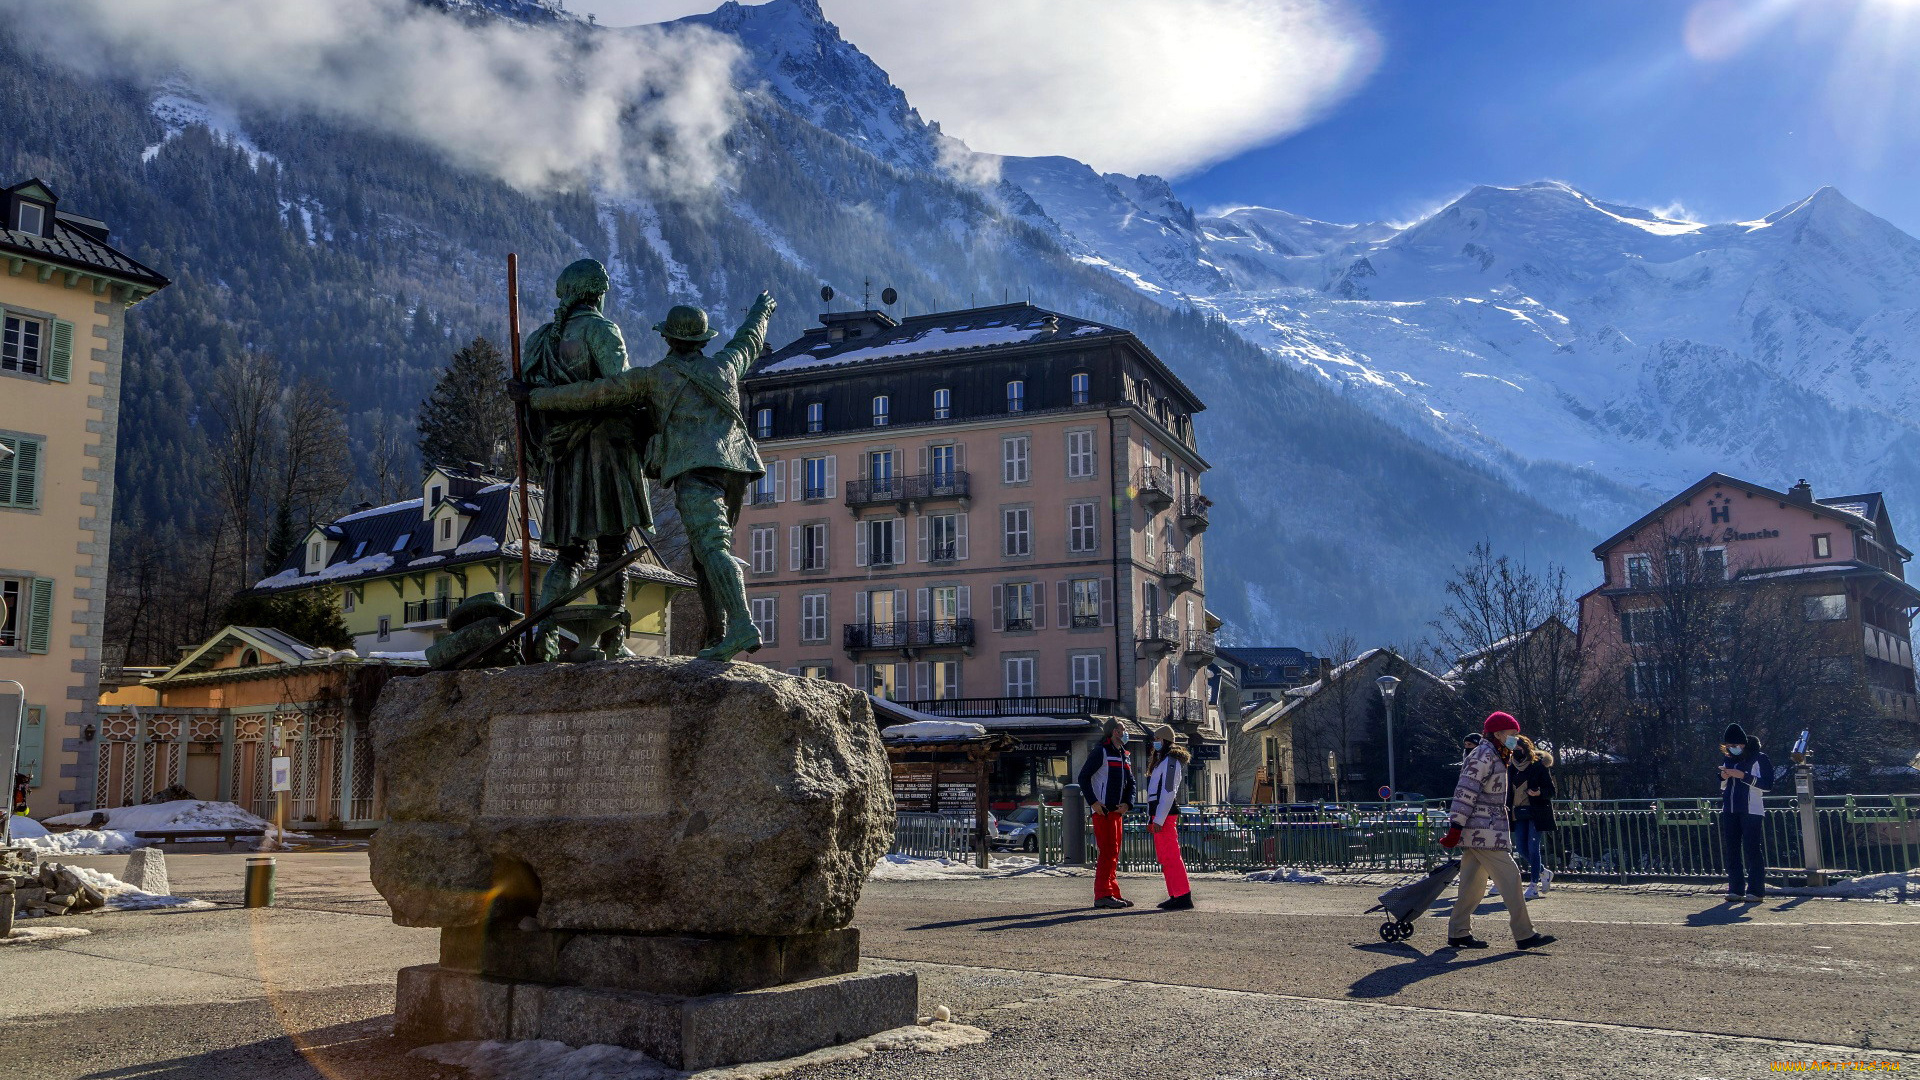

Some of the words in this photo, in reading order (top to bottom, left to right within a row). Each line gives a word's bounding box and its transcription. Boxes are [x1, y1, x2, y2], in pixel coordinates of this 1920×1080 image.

[1711, 505, 1730, 524] H
[1723, 527, 1779, 542] Blanche
[534, 735, 577, 748] CONCOURS
[604, 733, 631, 746] CLUB
[541, 751, 572, 762] SUISSE
[634, 764, 665, 777] BOSTO
[561, 781, 606, 795] TORISTES
